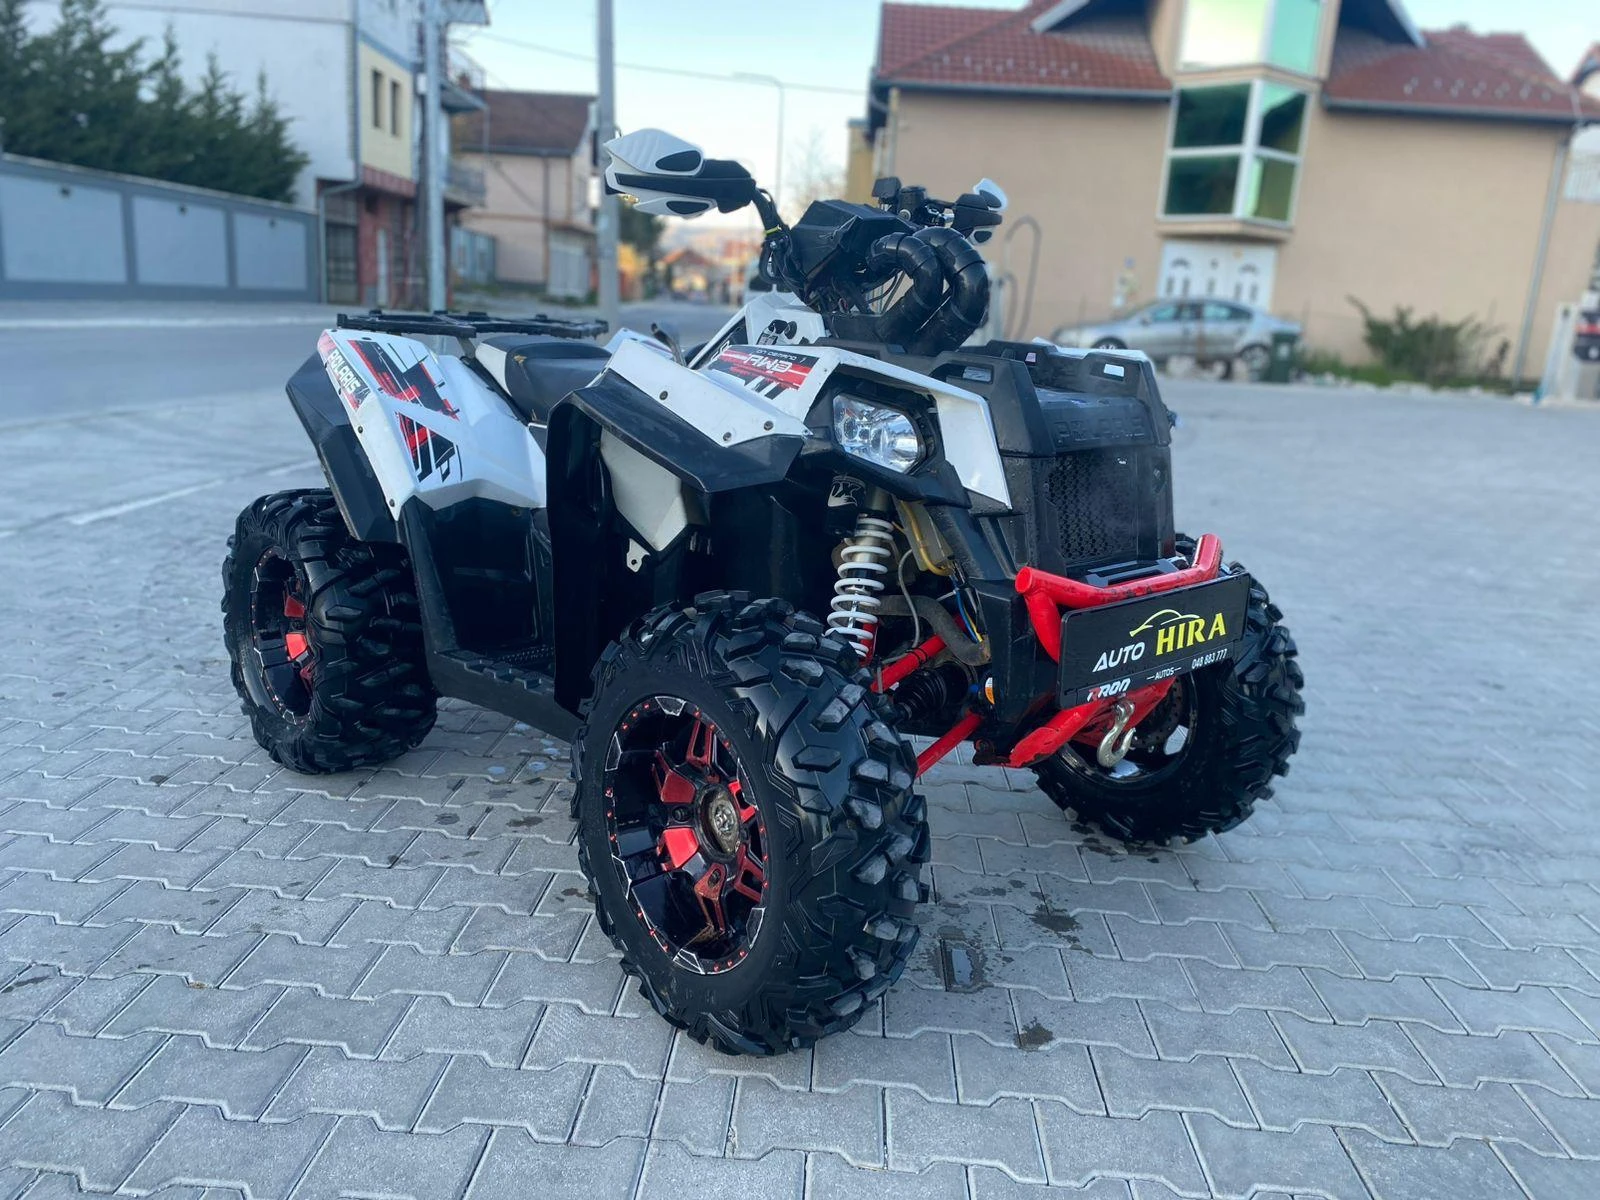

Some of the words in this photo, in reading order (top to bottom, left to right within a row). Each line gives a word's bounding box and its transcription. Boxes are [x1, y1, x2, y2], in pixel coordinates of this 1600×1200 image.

[327, 349, 361, 394] POLARIS
[1092, 642, 1145, 672] AUTO
[1156, 613, 1226, 655] HIRA
